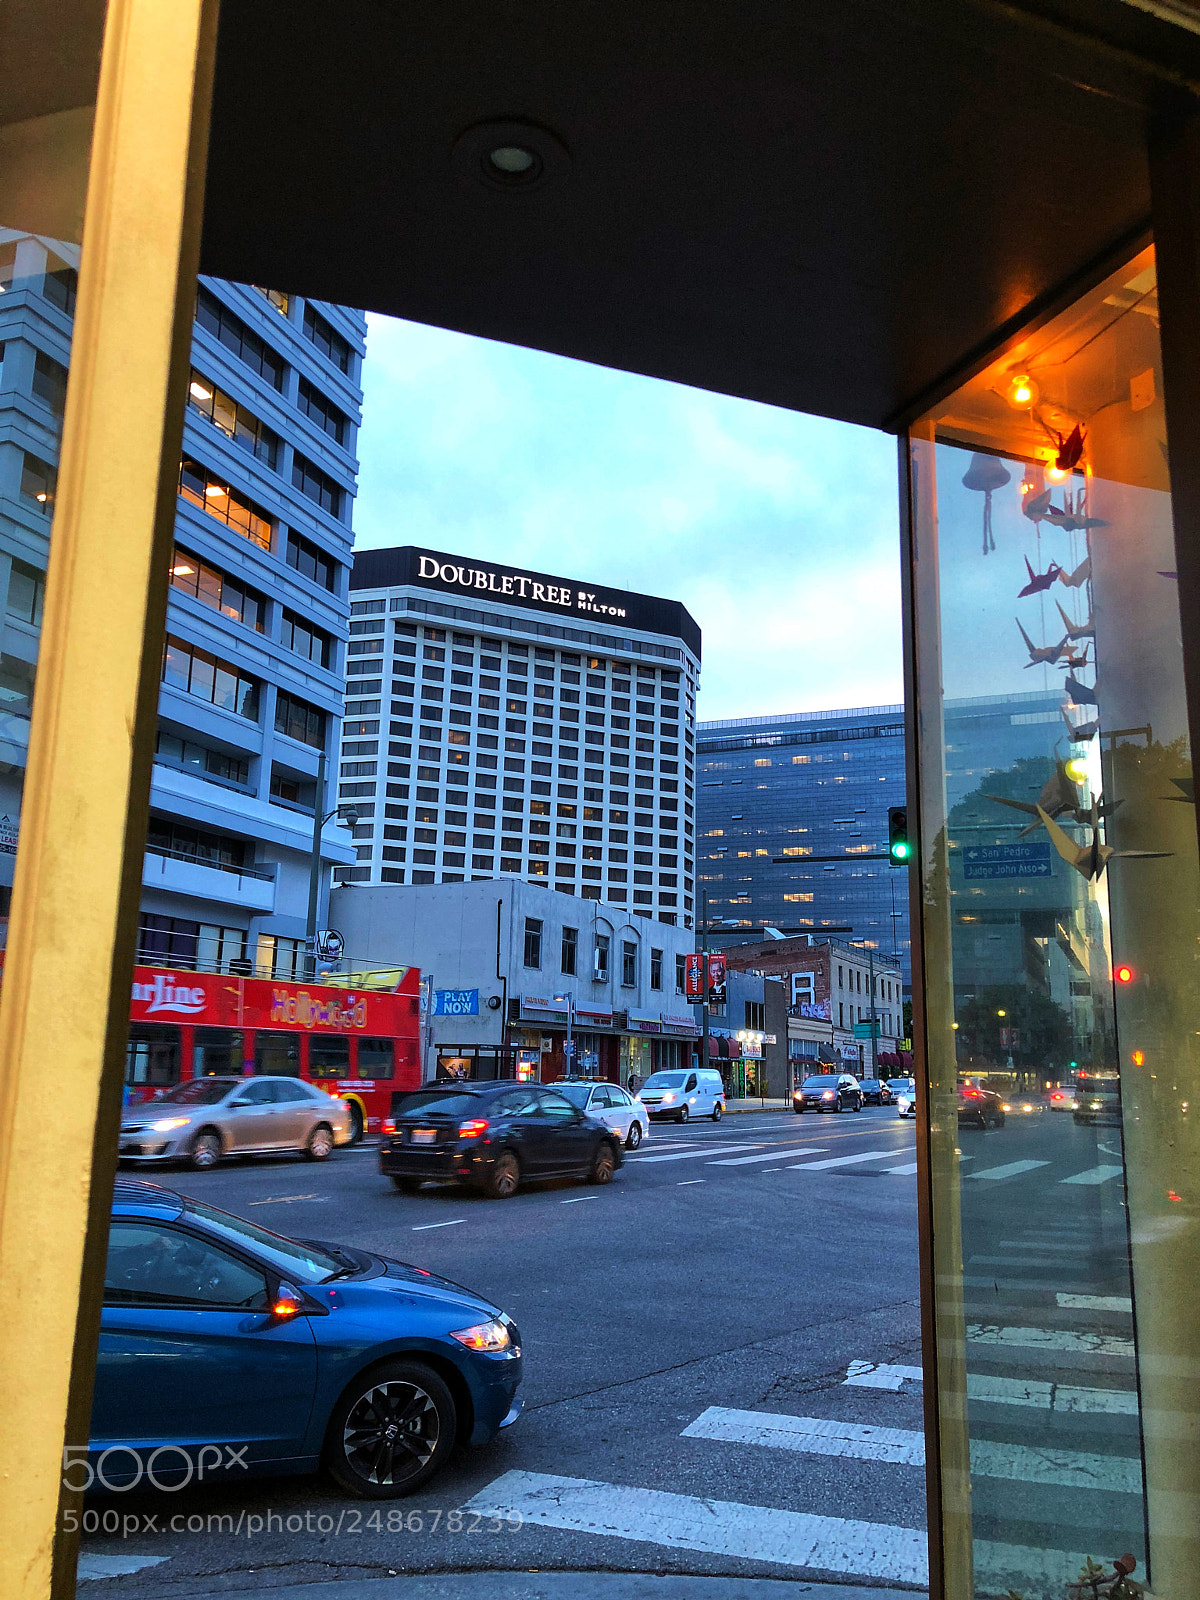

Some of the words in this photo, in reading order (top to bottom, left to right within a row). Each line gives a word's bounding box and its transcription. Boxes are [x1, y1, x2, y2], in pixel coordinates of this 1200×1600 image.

[578, 591, 596, 602] BY
[577, 601, 626, 618] HILTON
[1, 836, 19, 846] LEAS
[981, 848, 999, 858] San
[1004, 846, 1031, 857] Pedro
[968, 865, 993, 878] Judge
[995, 864, 1017, 875] John
[444, 991, 473, 1002] PLAY
[443, 1002, 472, 1014] NOW
